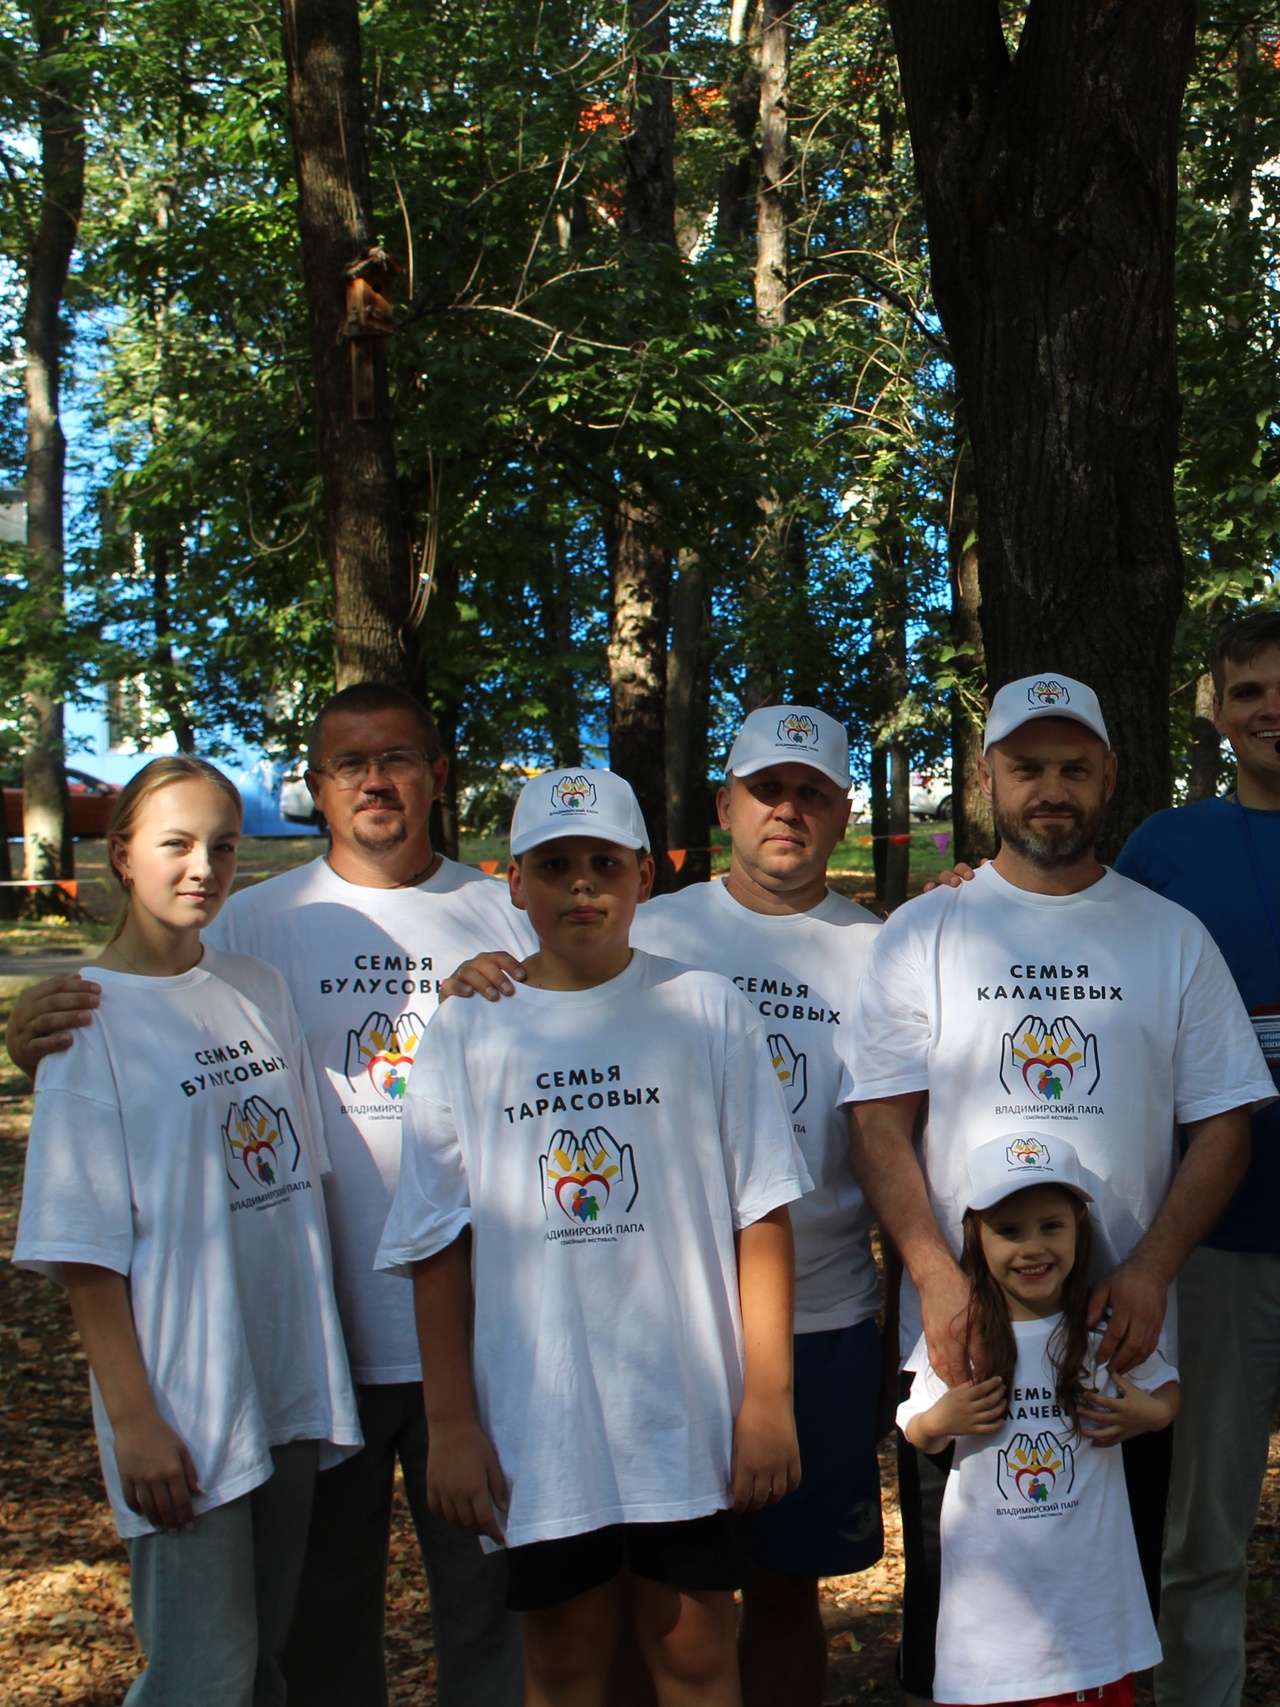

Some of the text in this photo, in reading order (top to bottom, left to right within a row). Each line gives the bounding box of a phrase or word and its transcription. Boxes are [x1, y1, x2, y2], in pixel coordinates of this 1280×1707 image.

[354, 955, 433, 971] СЕМЬЯ
[1010, 964, 1089, 979] СЕМЬЯ
[732, 976, 809, 999] СЕМЬЯ
[977, 985, 1123, 1001] КАЛАЧЕВЫХ
[758, 1000, 841, 1025] СОВЫХ
[194, 1040, 254, 1066] СЕМЬЯ
[180, 1057, 289, 1097] БУЛУСОВЫХ
[536, 1065, 621, 1089] СЕМЬЯ
[504, 1087, 660, 1123] ТАРАСОВЫХ
[995, 1103, 1104, 1116] ВЛАДИМИРСКИЙ ПАПА
[793, 1124, 806, 1134] ПА
[286, 1180, 312, 1193] ПАПА
[544, 1223, 645, 1242] АДИМИРСКИЙ ПАПА
[1014, 1387, 1052, 1401] ЕМЬ
[1003, 1404, 1070, 1421] ЛАЧЕВ
[996, 1502, 1059, 1516] ВЛАДИМИРСКИЙ
